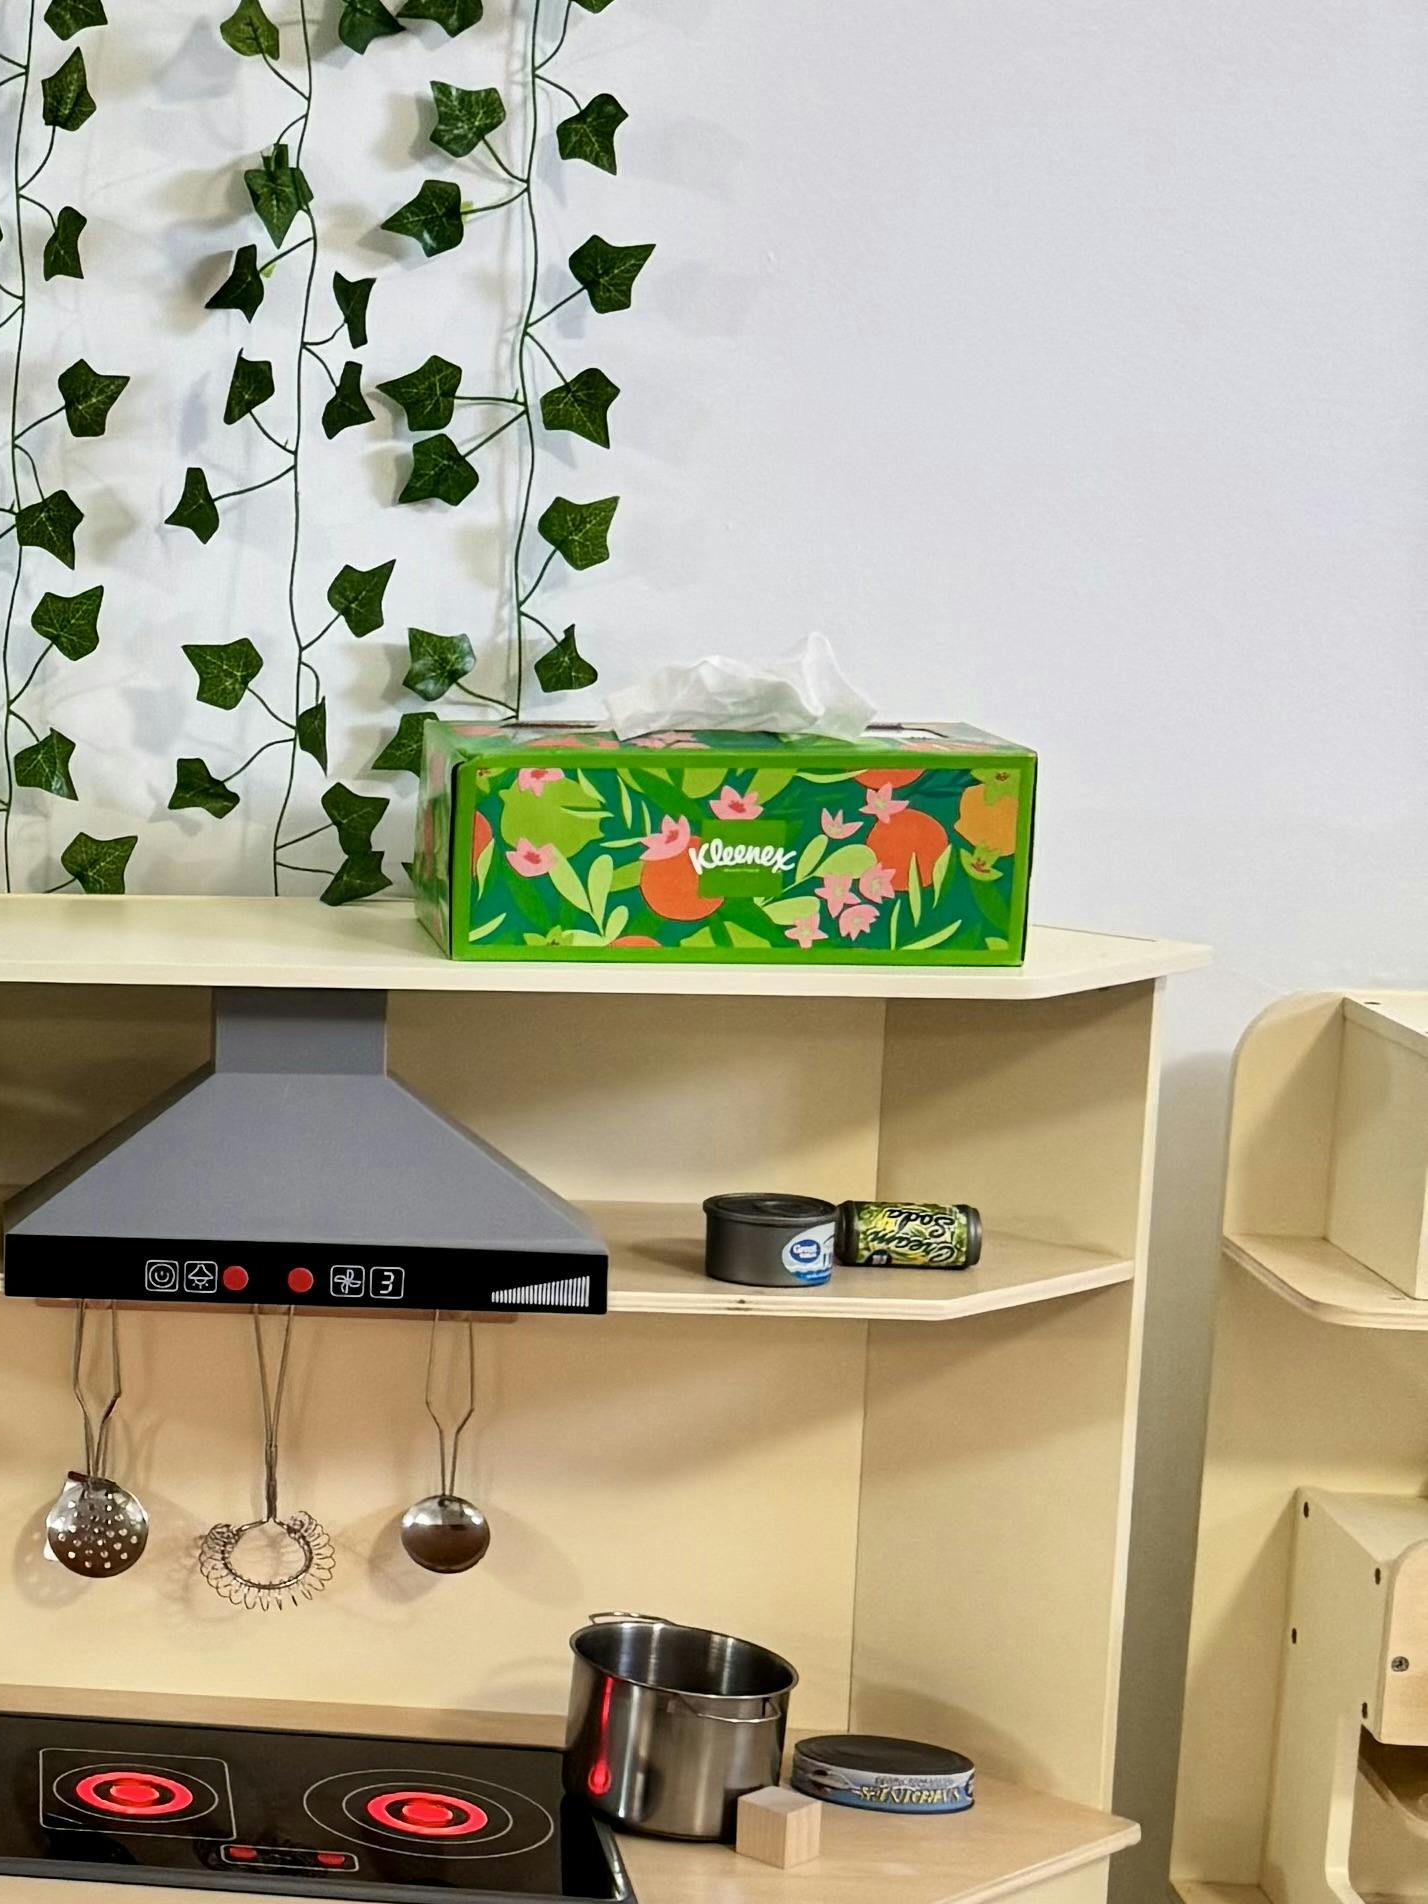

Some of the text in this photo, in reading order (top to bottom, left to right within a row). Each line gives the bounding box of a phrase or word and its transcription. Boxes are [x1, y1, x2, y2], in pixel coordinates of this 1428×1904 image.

[688, 838, 797, 875] Kleenex
[884, 1209, 955, 1239] Soda
[868, 1230, 956, 1265] Cream
[379, 1271, 395, 1294] 3
